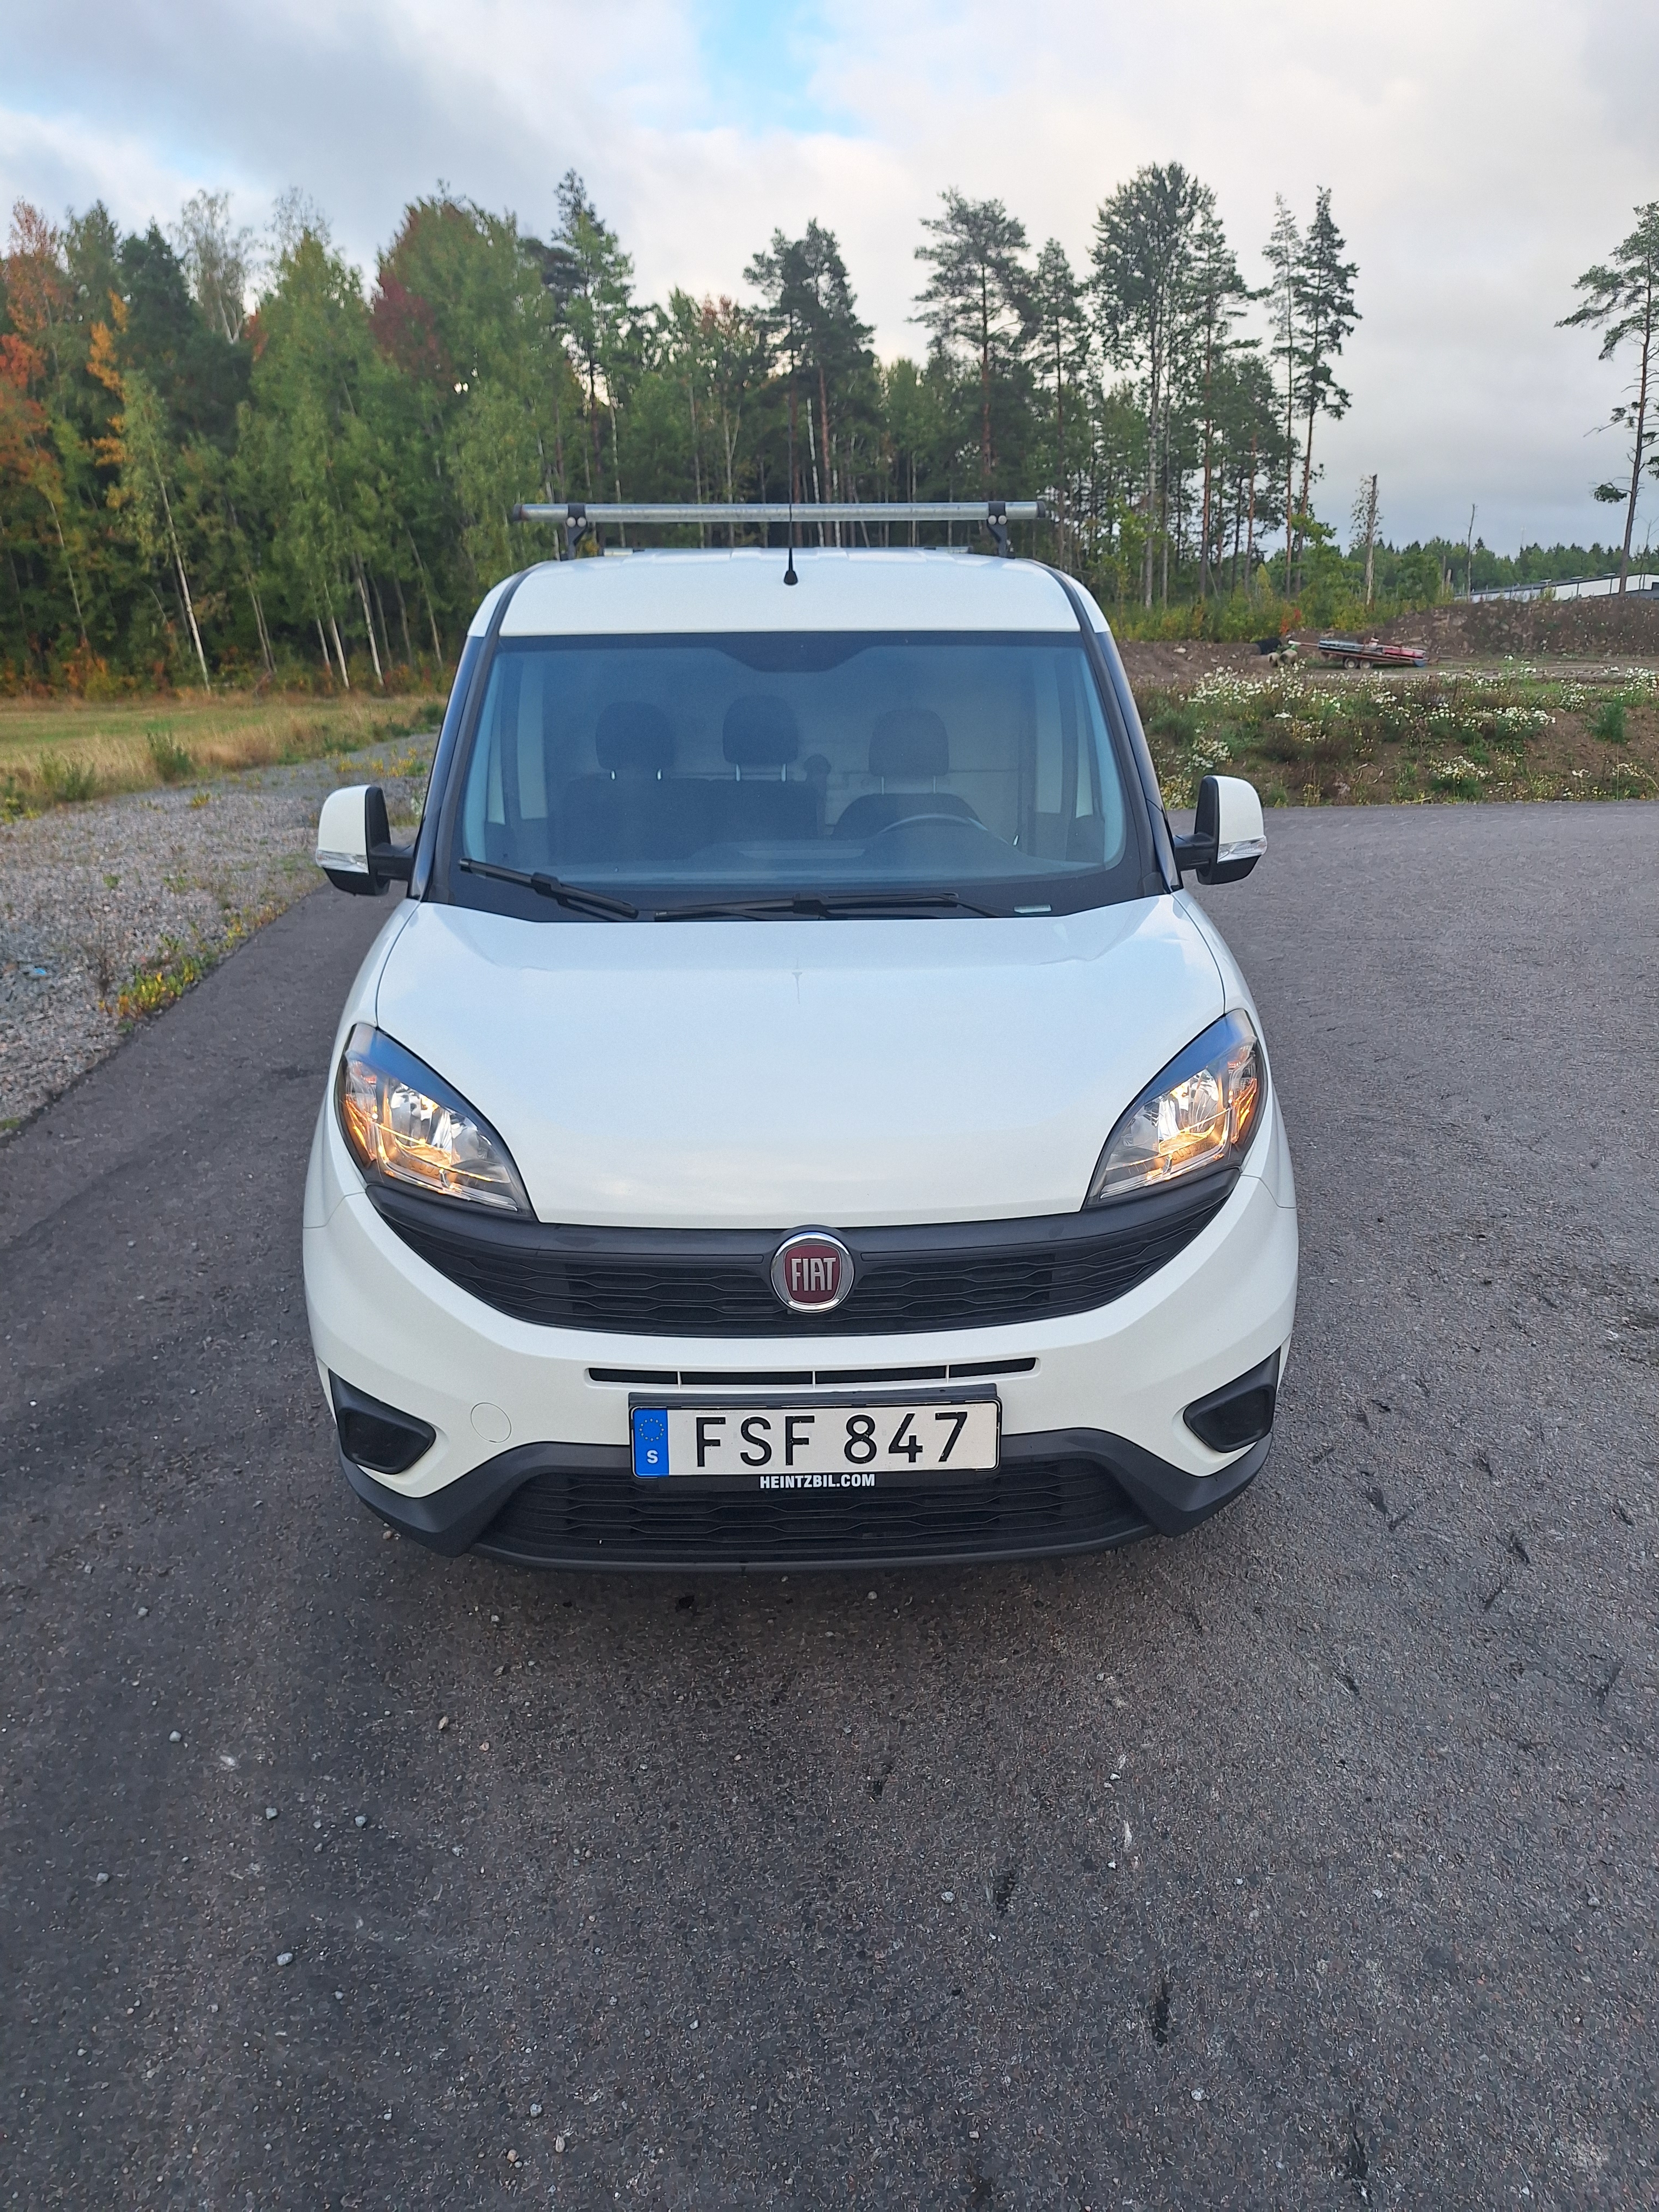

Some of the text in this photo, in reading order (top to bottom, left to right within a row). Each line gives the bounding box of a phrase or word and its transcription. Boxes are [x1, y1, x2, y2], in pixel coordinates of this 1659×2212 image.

[791, 1257, 837, 1291] FIAT
[696, 1411, 968, 1467] FSF 847
[647, 1450, 658, 1464] S
[760, 1474, 875, 1489] HEINTZBIL.COM
